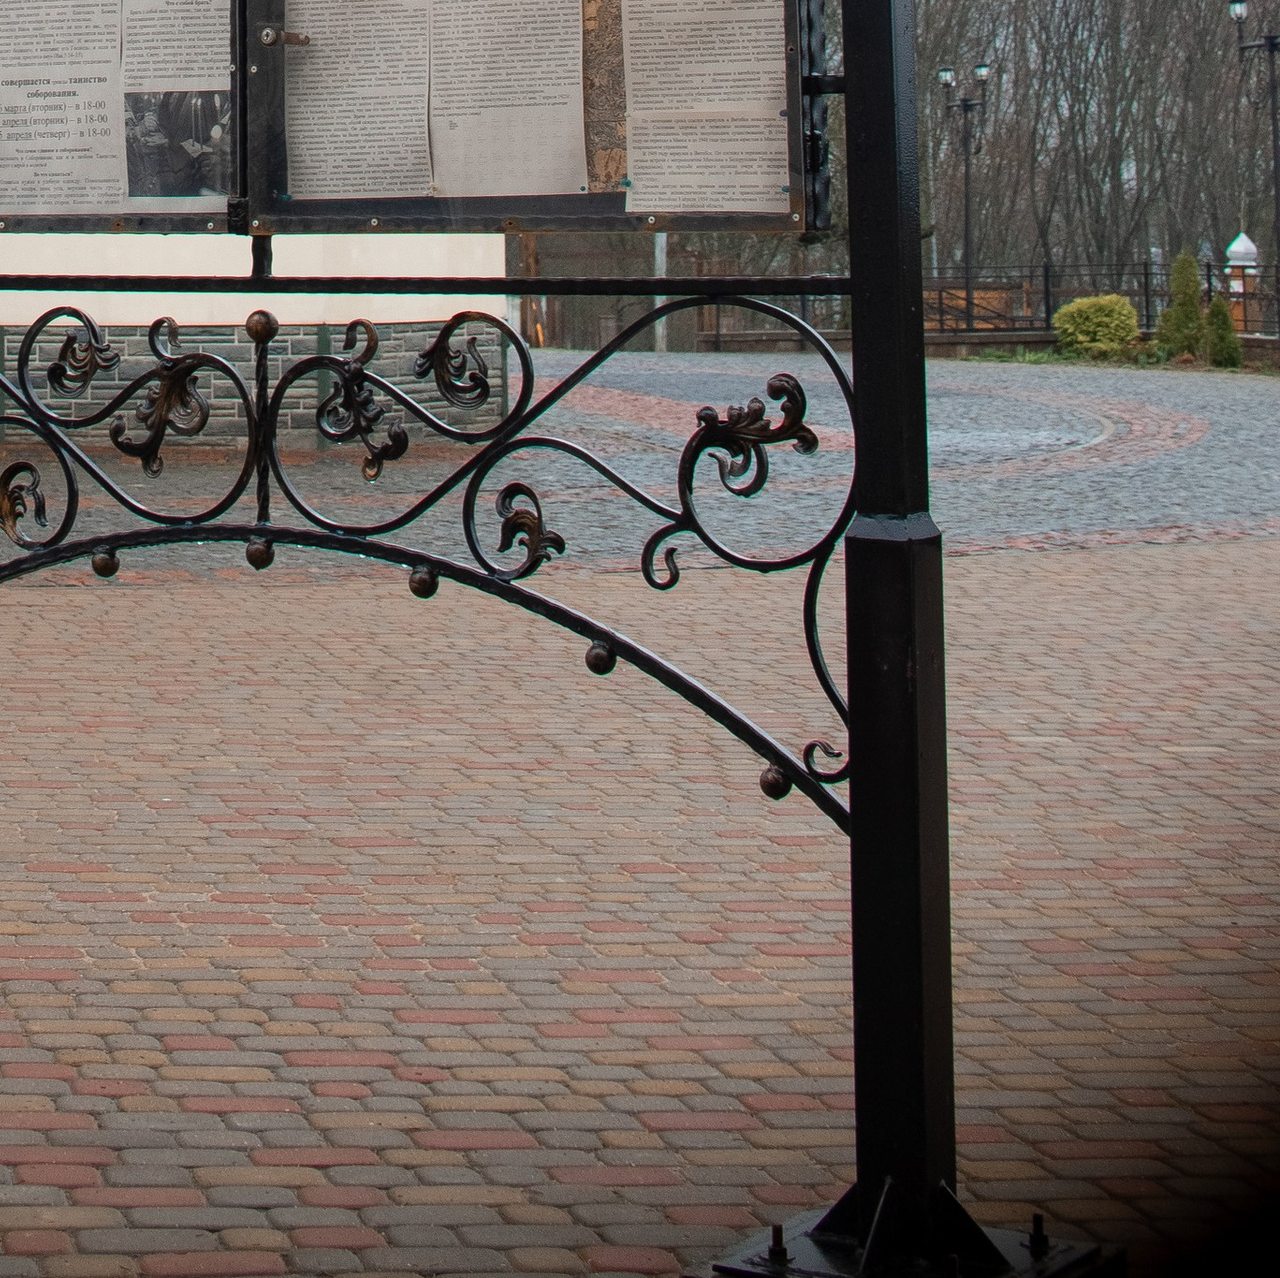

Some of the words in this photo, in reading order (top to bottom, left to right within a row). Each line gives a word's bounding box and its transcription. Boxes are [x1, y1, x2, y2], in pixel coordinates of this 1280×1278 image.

[0, 77, 50, 88] совершается
[68, 76, 107, 84] таинство
[26, 89, 79, 100] соборования.
[4, 105, 27, 114] марта
[28, 102, 66, 113] (вторник)
[83, 100, 106, 111] 18-00
[2, 118, 28, 127] апреля
[29, 116, 68, 127] (вторник)
[85, 113, 108, 124] 18-00
[6, 131, 33, 141] апреля
[34, 129, 70, 140] (четверг)
[87, 127, 111, 137] 18-00
